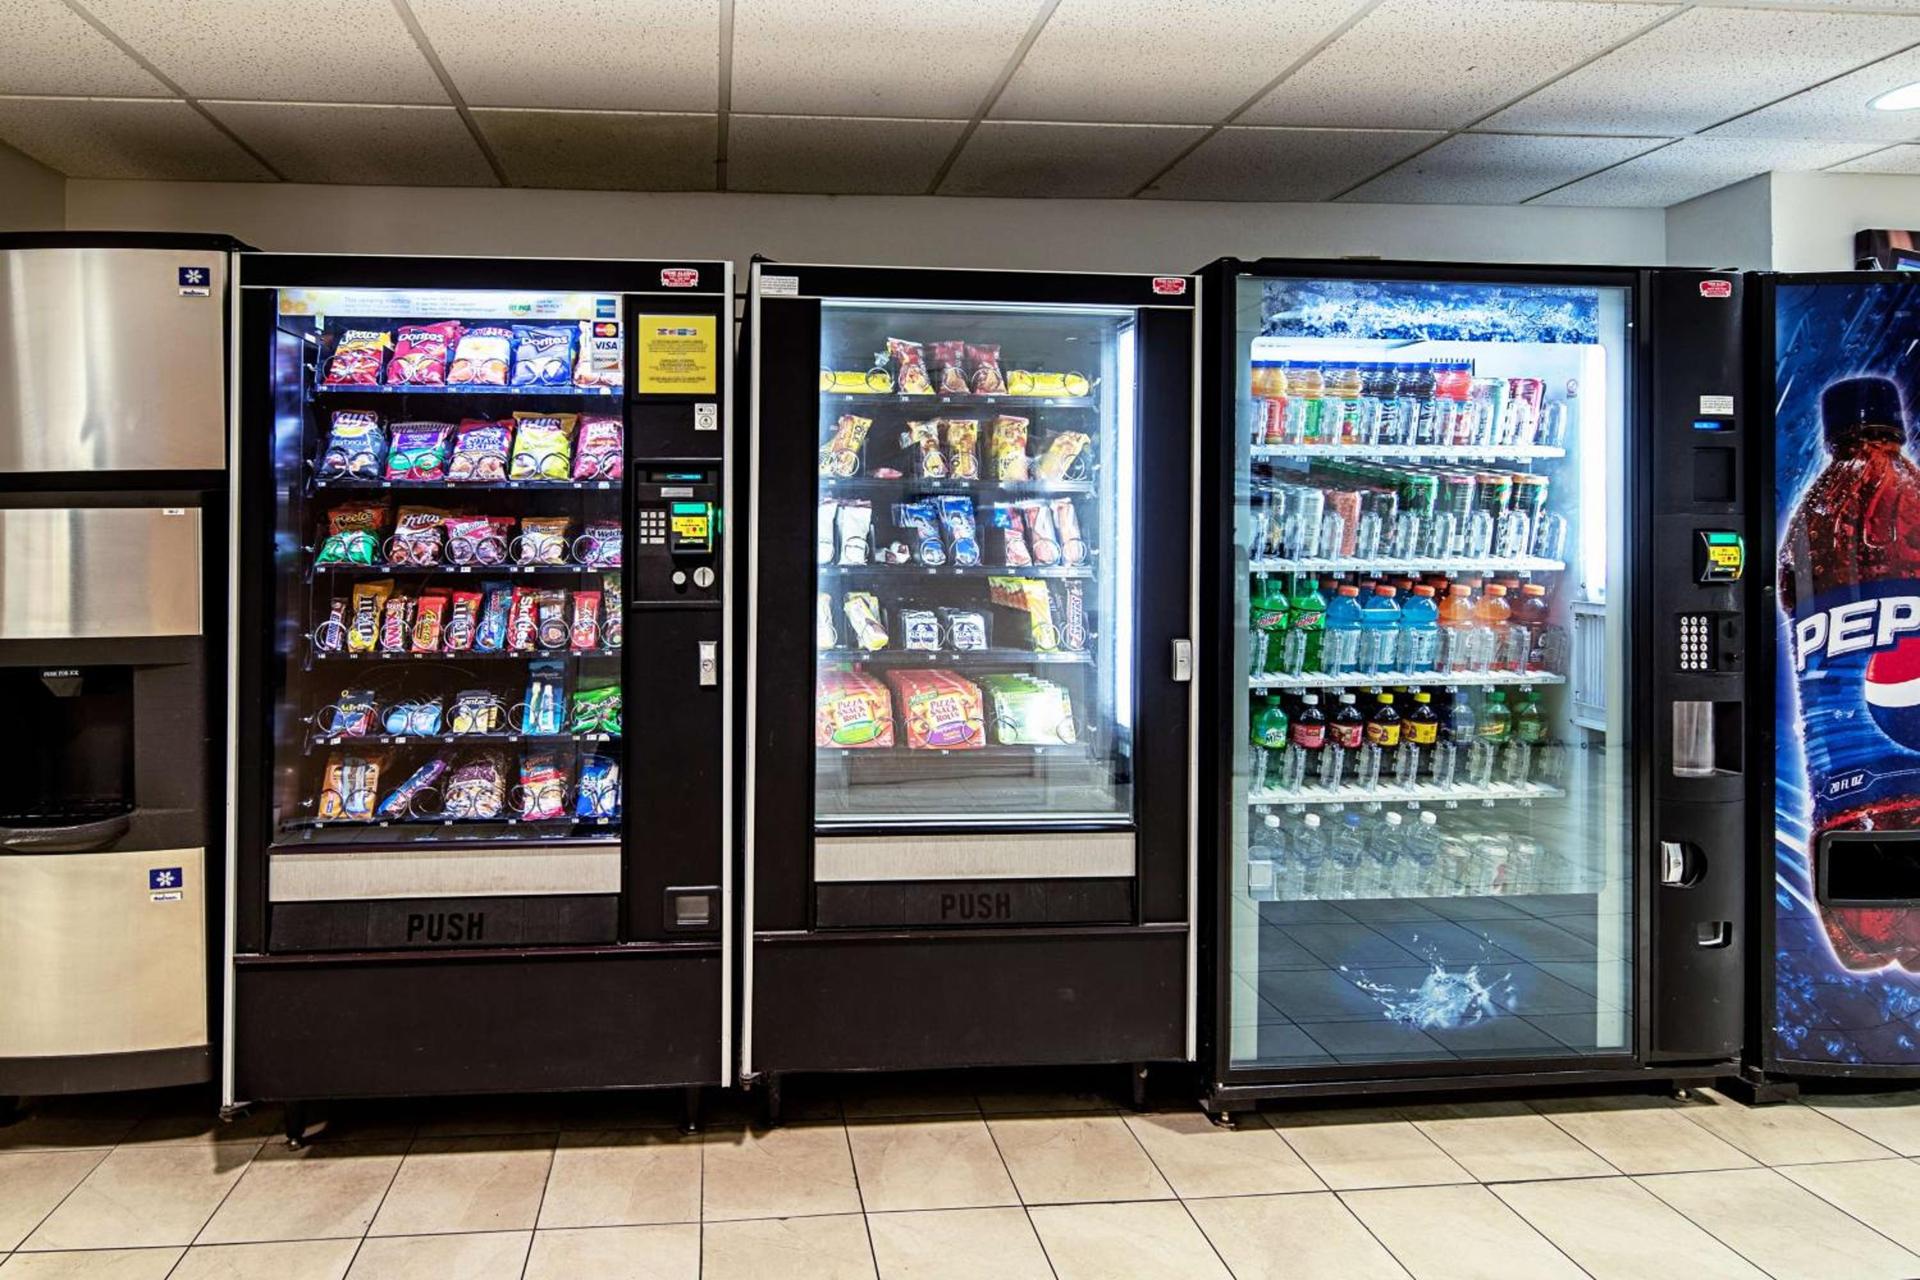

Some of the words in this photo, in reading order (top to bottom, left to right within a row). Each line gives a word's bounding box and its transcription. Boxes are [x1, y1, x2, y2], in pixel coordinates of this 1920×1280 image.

[398, 331, 445, 343] Doritos
[521, 335, 569, 346] Doritos
[595, 341, 618, 350] VISA
[515, 596, 533, 649] Skittles
[1796, 596, 1920, 672] PEP
[930, 698, 955, 708] PIZZA
[930, 706, 959, 715] SNACK
[936, 712, 960, 722] ROLLS
[1829, 781, 1840, 793] 20
[1841, 778, 1850, 791] FL
[1850, 774, 1864, 787] OZ
[941, 894, 1012, 920] PUSH
[407, 912, 484, 942] PUSH
